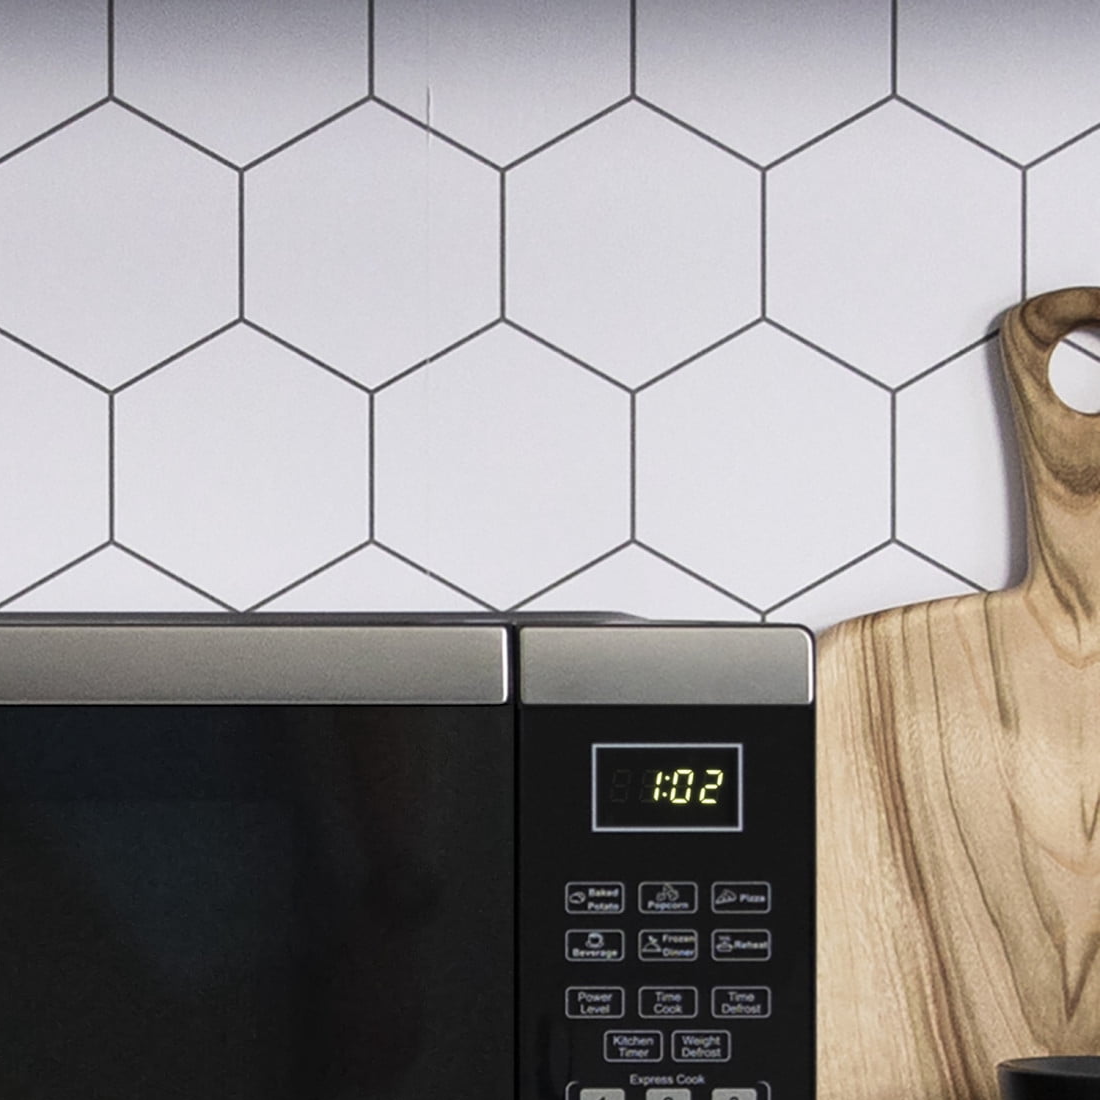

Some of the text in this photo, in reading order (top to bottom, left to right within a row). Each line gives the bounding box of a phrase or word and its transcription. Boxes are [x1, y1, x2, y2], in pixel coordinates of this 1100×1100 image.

[653, 769, 723, 804] 1:02
[739, 893, 766, 902] Pizza
[647, 900, 689, 911] Popcorn
[662, 934, 695, 943] Frozen
[734, 940, 768, 949] Reheat
[572, 948, 618, 959] Beverage
[663, 948, 695, 957] Dinner
[577, 992, 612, 1002] Power
[655, 992, 682, 1002] Time
[728, 992, 755, 1002] Time
[580, 1004, 610, 1014] Level
[653, 1004, 683, 1014] Cook
[721, 1004, 762, 1014] Defrost
[613, 1035, 654, 1046] Kitchen
[681, 1035, 721, 1048] Weight
[618, 1047, 650, 1057] Timer
[681, 1047, 722, 1058] Defrost
[629, 1074, 705, 1086] Express Cook
